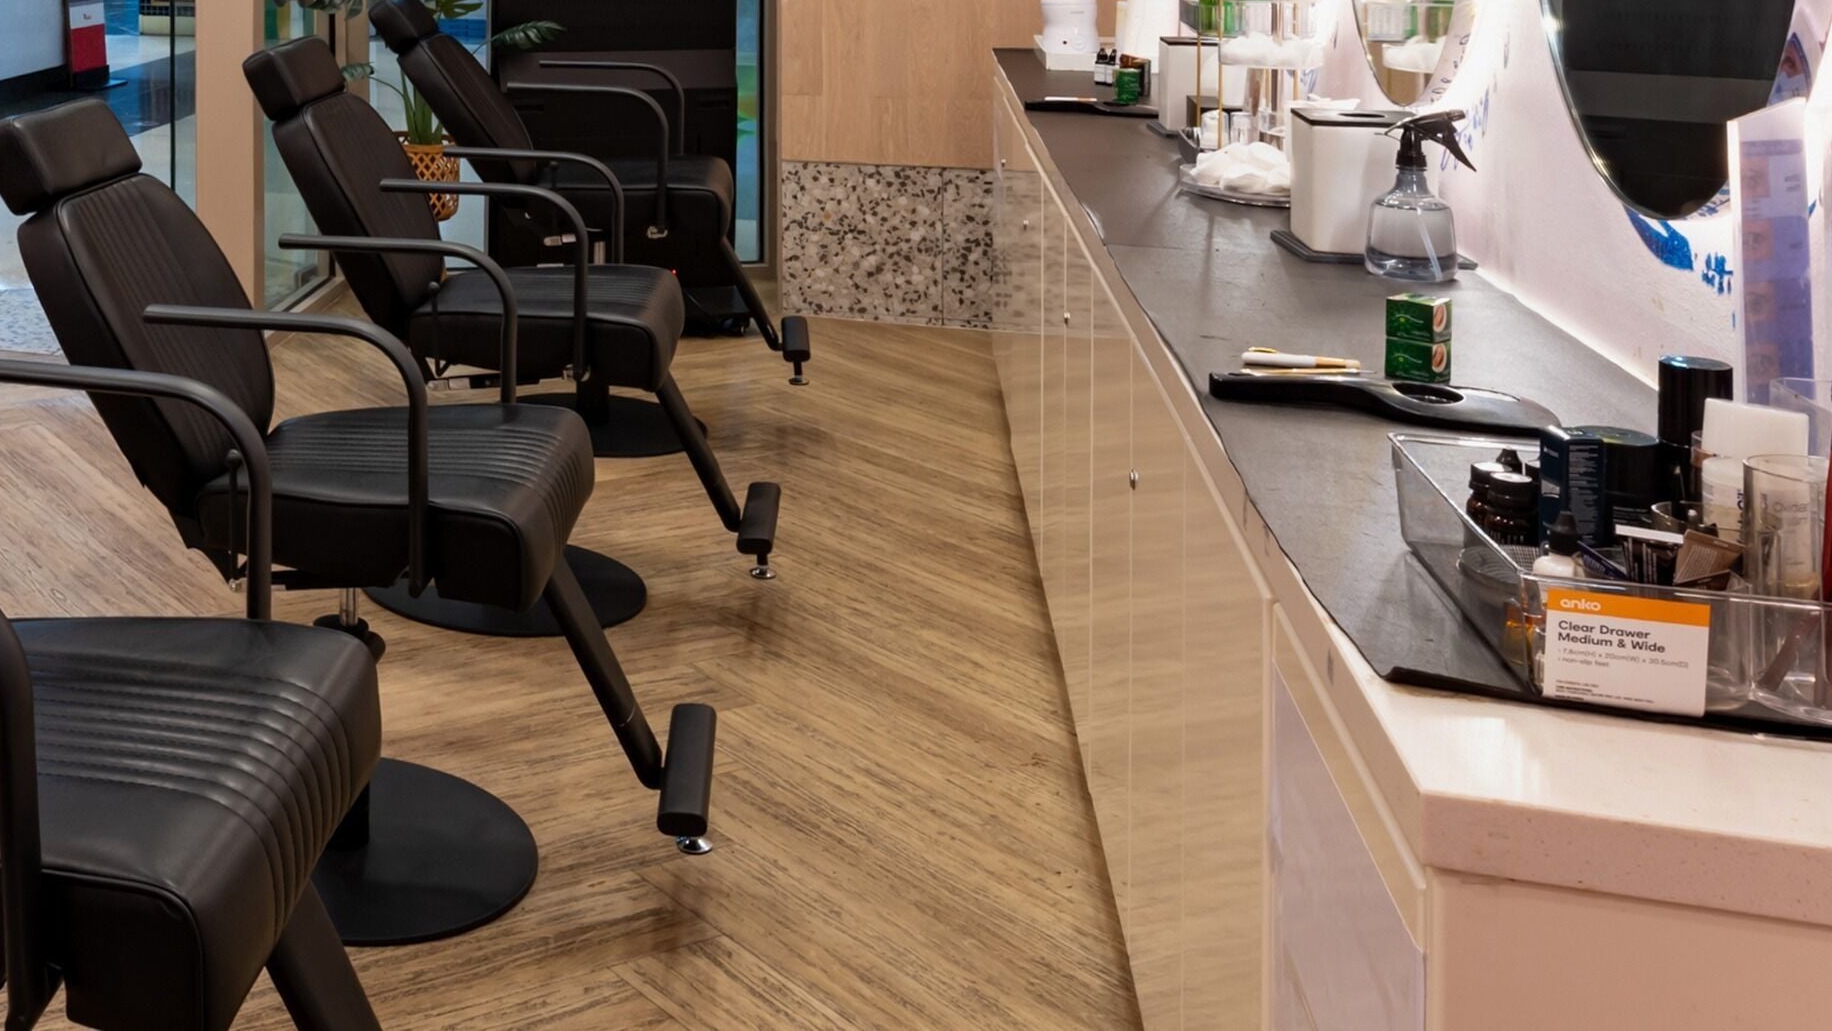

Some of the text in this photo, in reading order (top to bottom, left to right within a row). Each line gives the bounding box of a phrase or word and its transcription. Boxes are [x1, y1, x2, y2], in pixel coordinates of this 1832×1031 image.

[1559, 598, 1602, 612] anko
[1557, 619, 1651, 640] Clear Drawer
[1557, 632, 1666, 654] Medium & Wide
